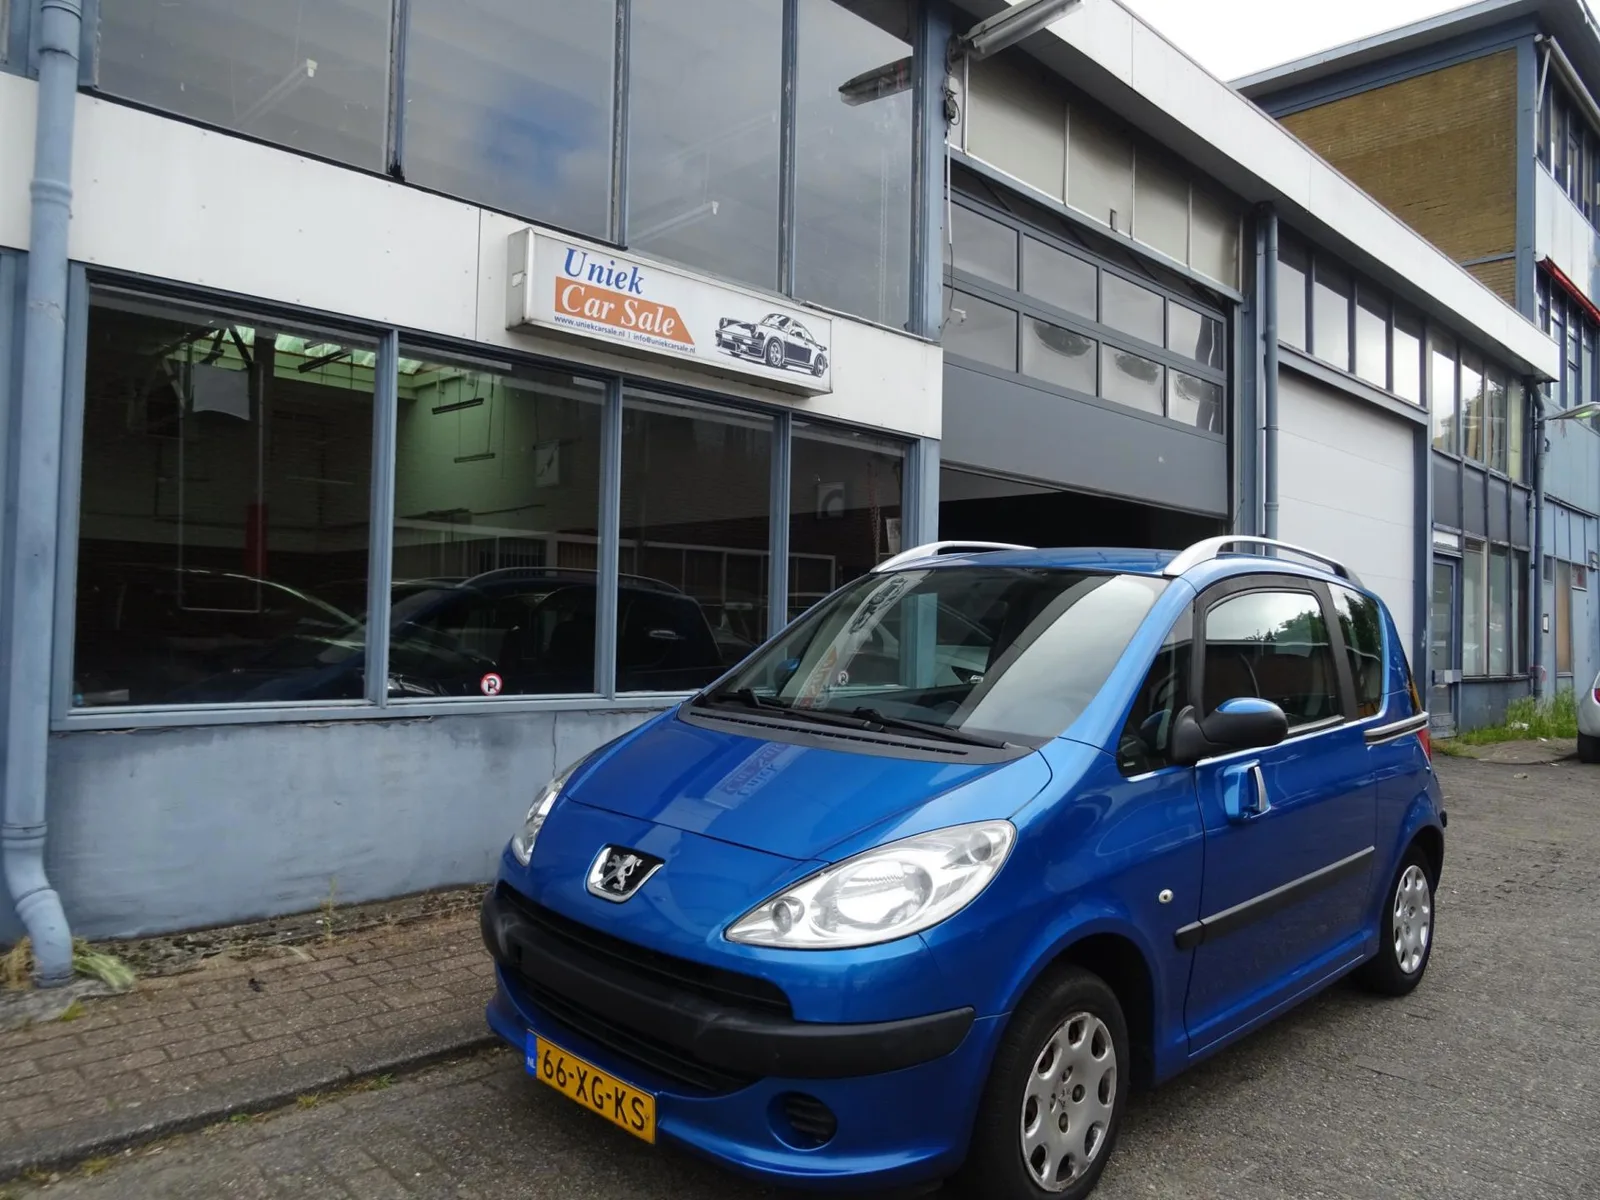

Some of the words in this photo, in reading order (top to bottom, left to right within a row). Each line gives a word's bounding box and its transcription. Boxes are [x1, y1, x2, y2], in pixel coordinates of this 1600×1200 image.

[564, 248, 644, 294] Uniek
[561, 284, 615, 319] Car
[620, 299, 675, 335] Sale
[554, 315, 625, 337] www.uniekcarsale.nl
[633, 333, 696, 353] info@uniekcarsale.nl
[543, 1050, 645, 1131] 66-XG-KS
